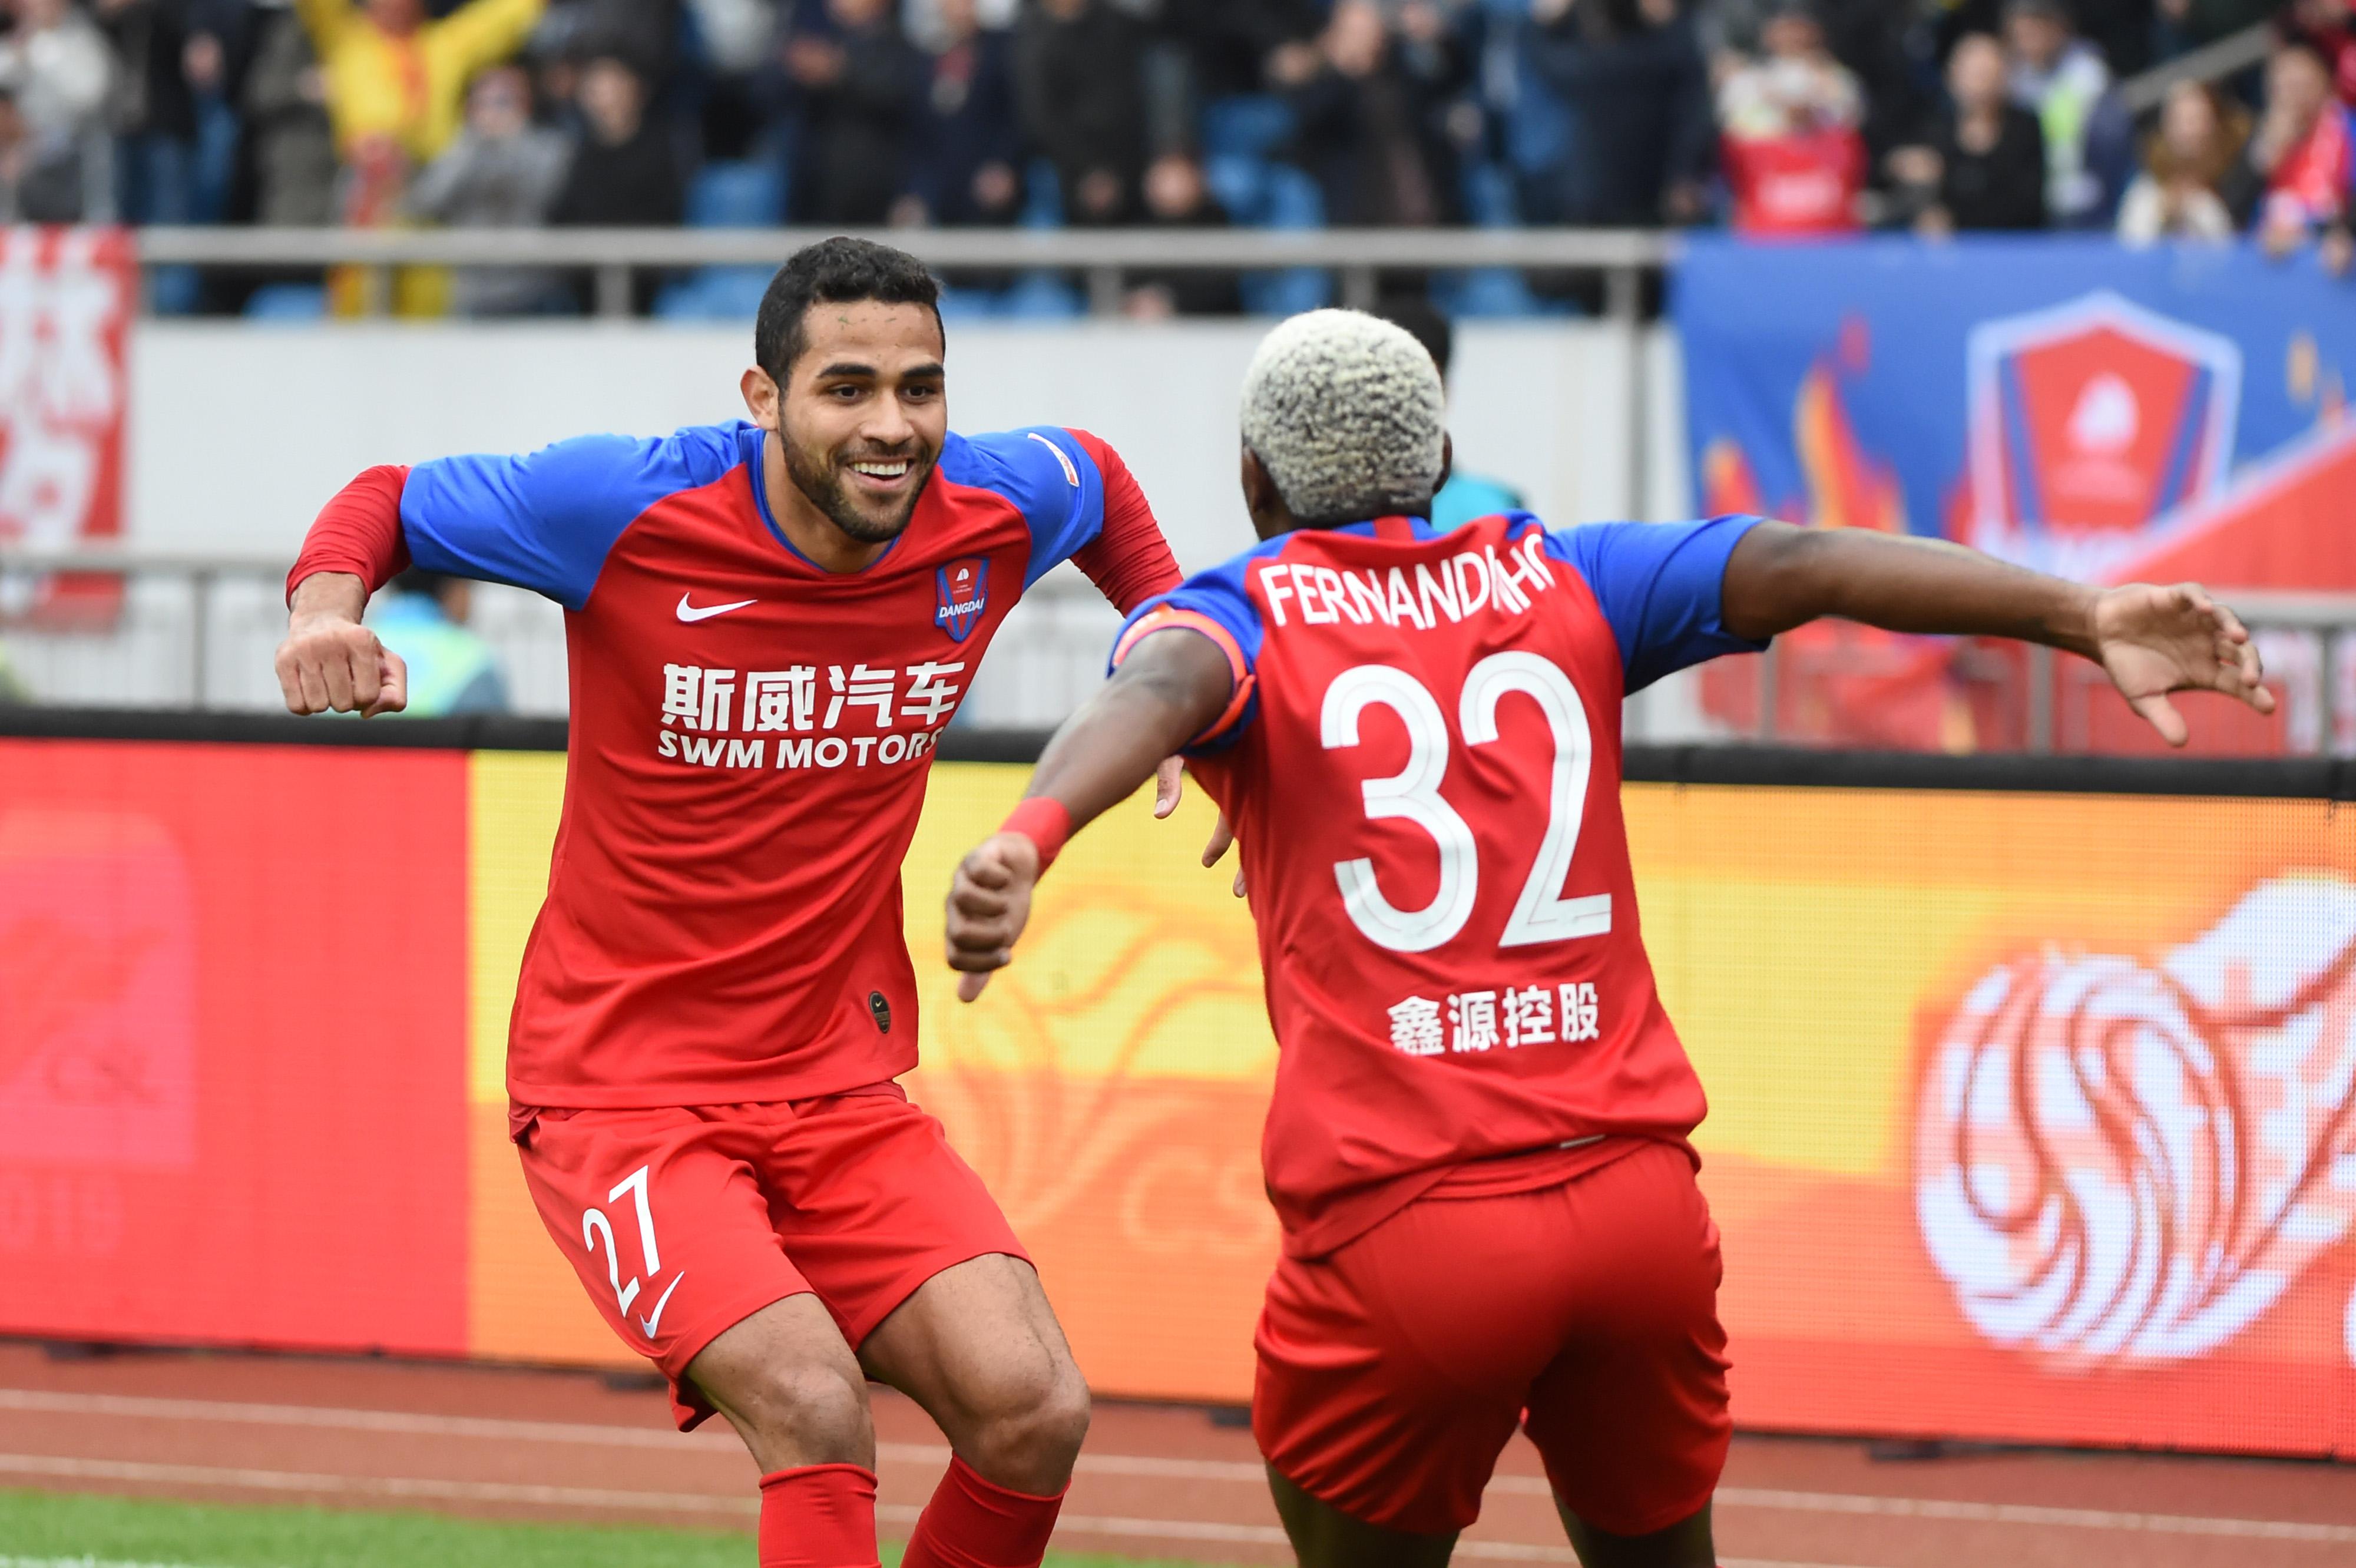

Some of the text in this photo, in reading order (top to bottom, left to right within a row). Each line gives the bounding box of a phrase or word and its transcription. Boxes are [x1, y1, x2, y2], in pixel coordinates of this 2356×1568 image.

[939, 597, 984, 618] DANGDAI
[661, 661, 965, 732] 斯威汽车
[658, 728, 942, 769] SWM MOTORS
[1321, 650, 1613, 952] 32
[1387, 982, 1600, 1056] 鑫源控股
[582, 1164, 661, 1318] 27
